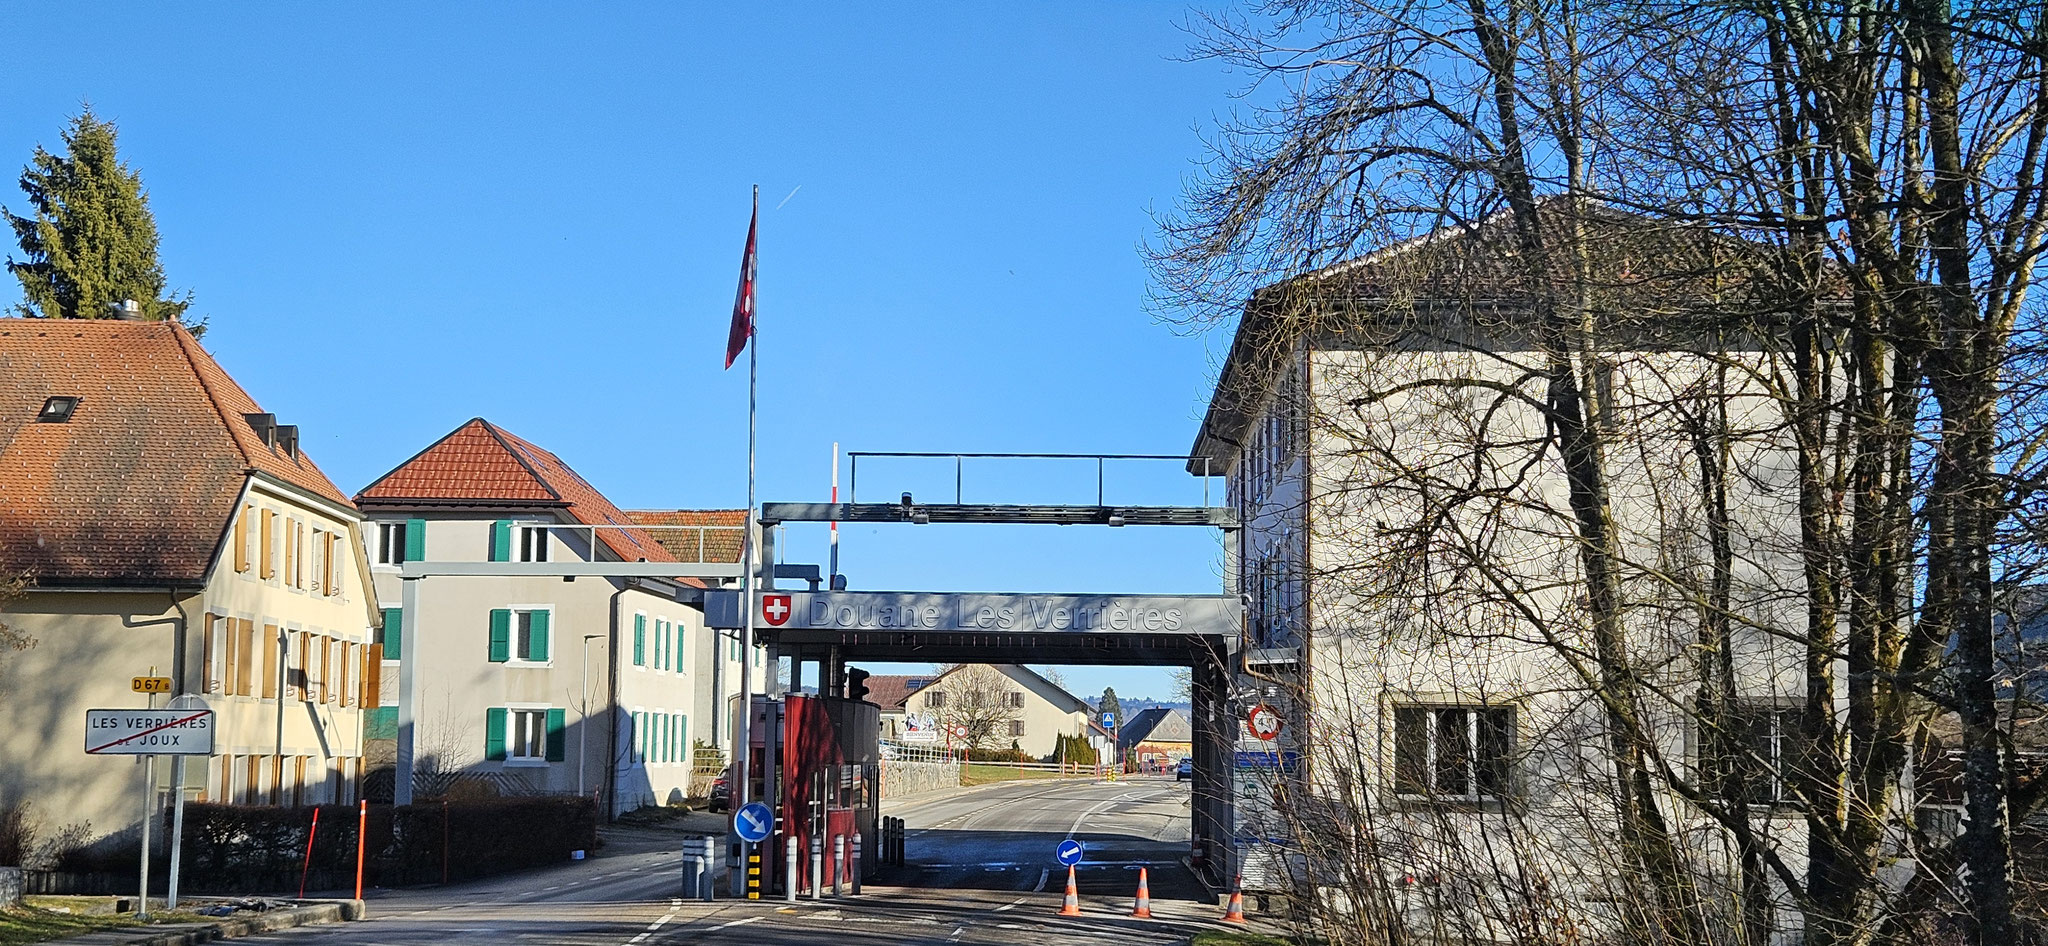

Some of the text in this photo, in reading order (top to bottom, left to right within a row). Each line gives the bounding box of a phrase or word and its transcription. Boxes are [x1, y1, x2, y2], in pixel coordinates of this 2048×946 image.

[809, 596, 1183, 631] Douane Les Verrières
[92, 716, 207, 729] LES VERRIÈRES
[139, 735, 181, 746] JOUX
